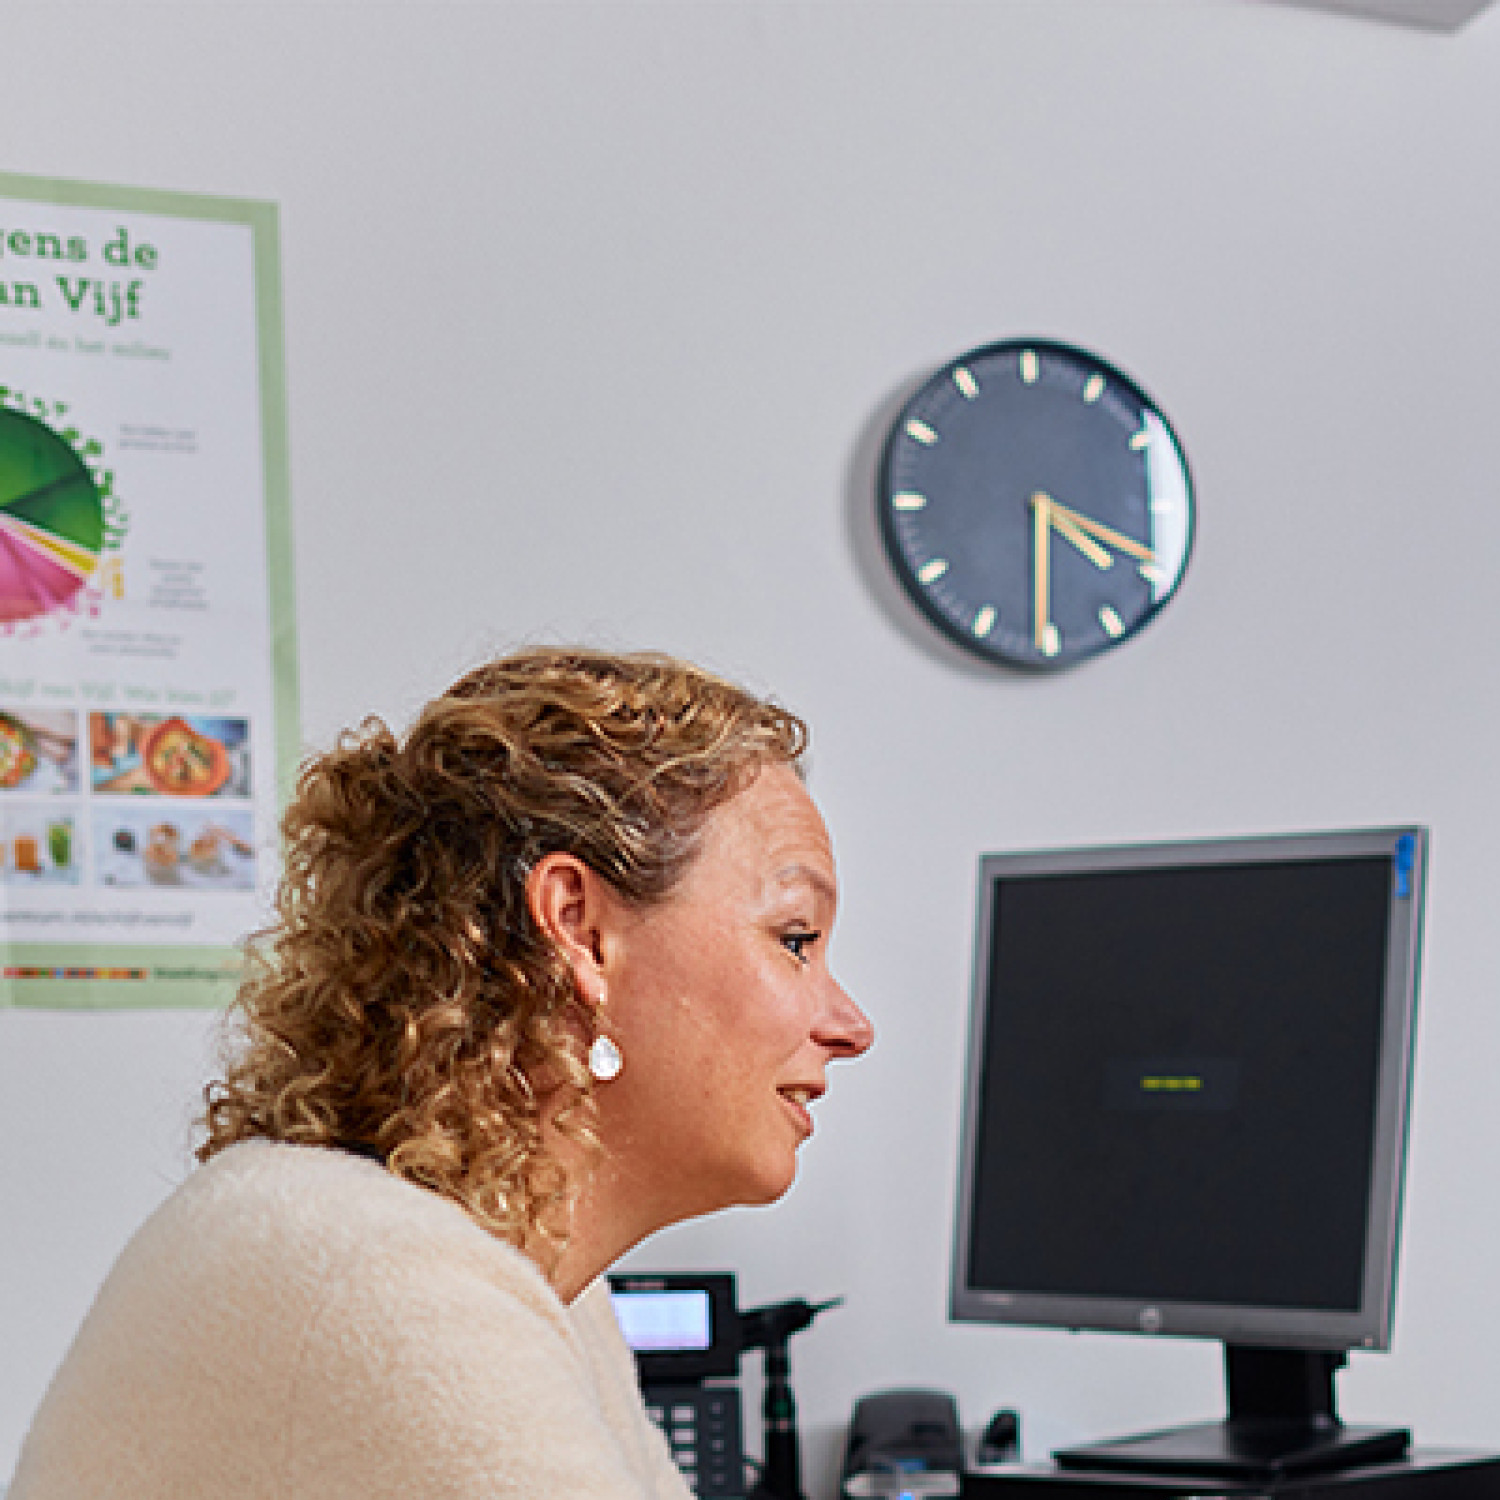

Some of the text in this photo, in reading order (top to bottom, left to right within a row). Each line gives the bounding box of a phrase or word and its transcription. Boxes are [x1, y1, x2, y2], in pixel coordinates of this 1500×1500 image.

[0, 225, 158, 269] ens de
[55, 274, 143, 327] Vijf
